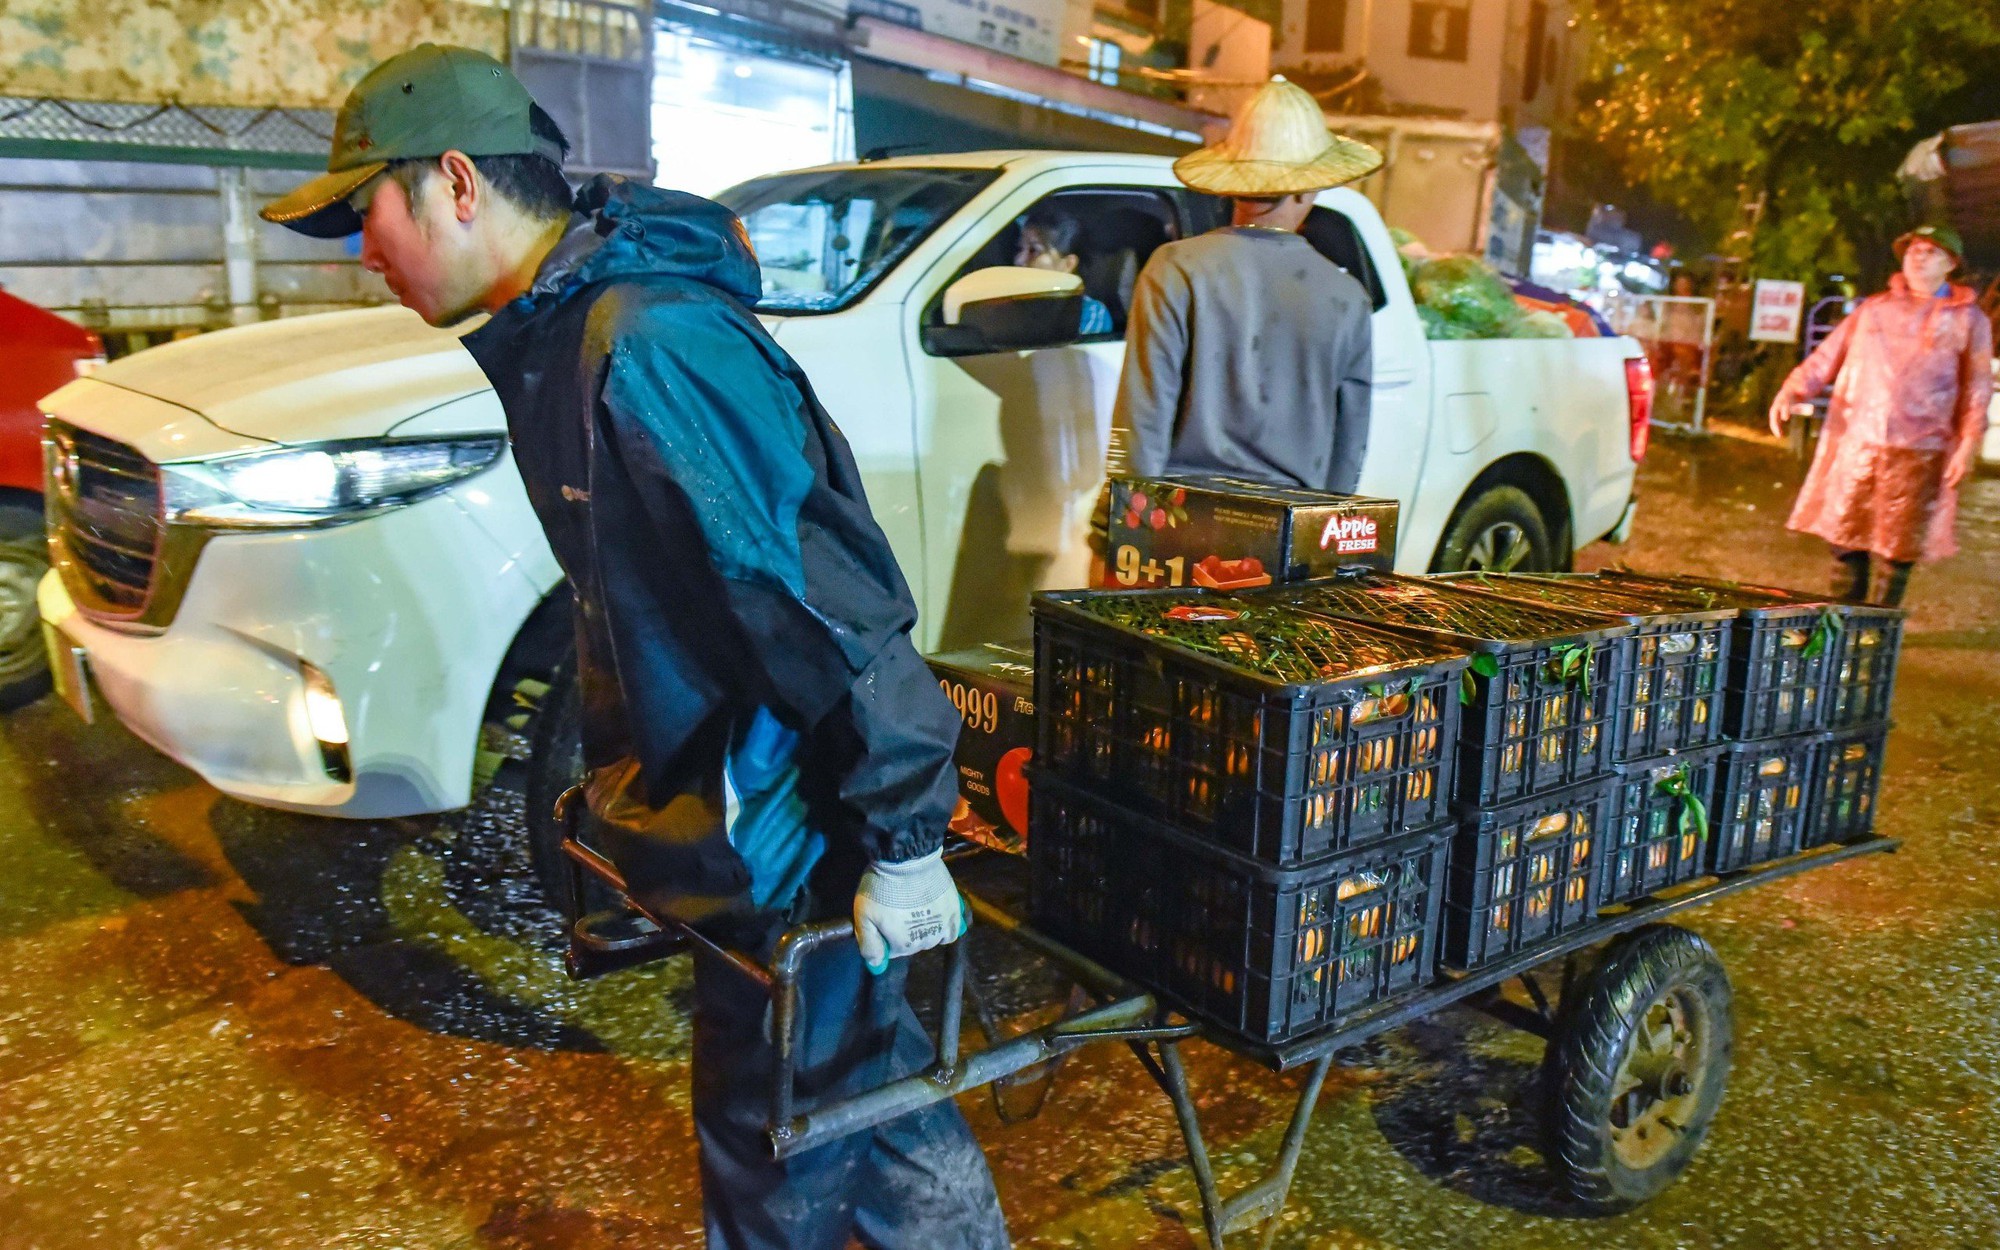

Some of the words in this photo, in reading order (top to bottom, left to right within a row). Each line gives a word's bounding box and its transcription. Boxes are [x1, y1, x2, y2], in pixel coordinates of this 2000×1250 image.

[1337, 538, 1377, 551] FRESH
[1116, 545, 1185, 586] 9+1
[959, 765, 984, 781] MIGHTY
[966, 780, 990, 796] GOODS
